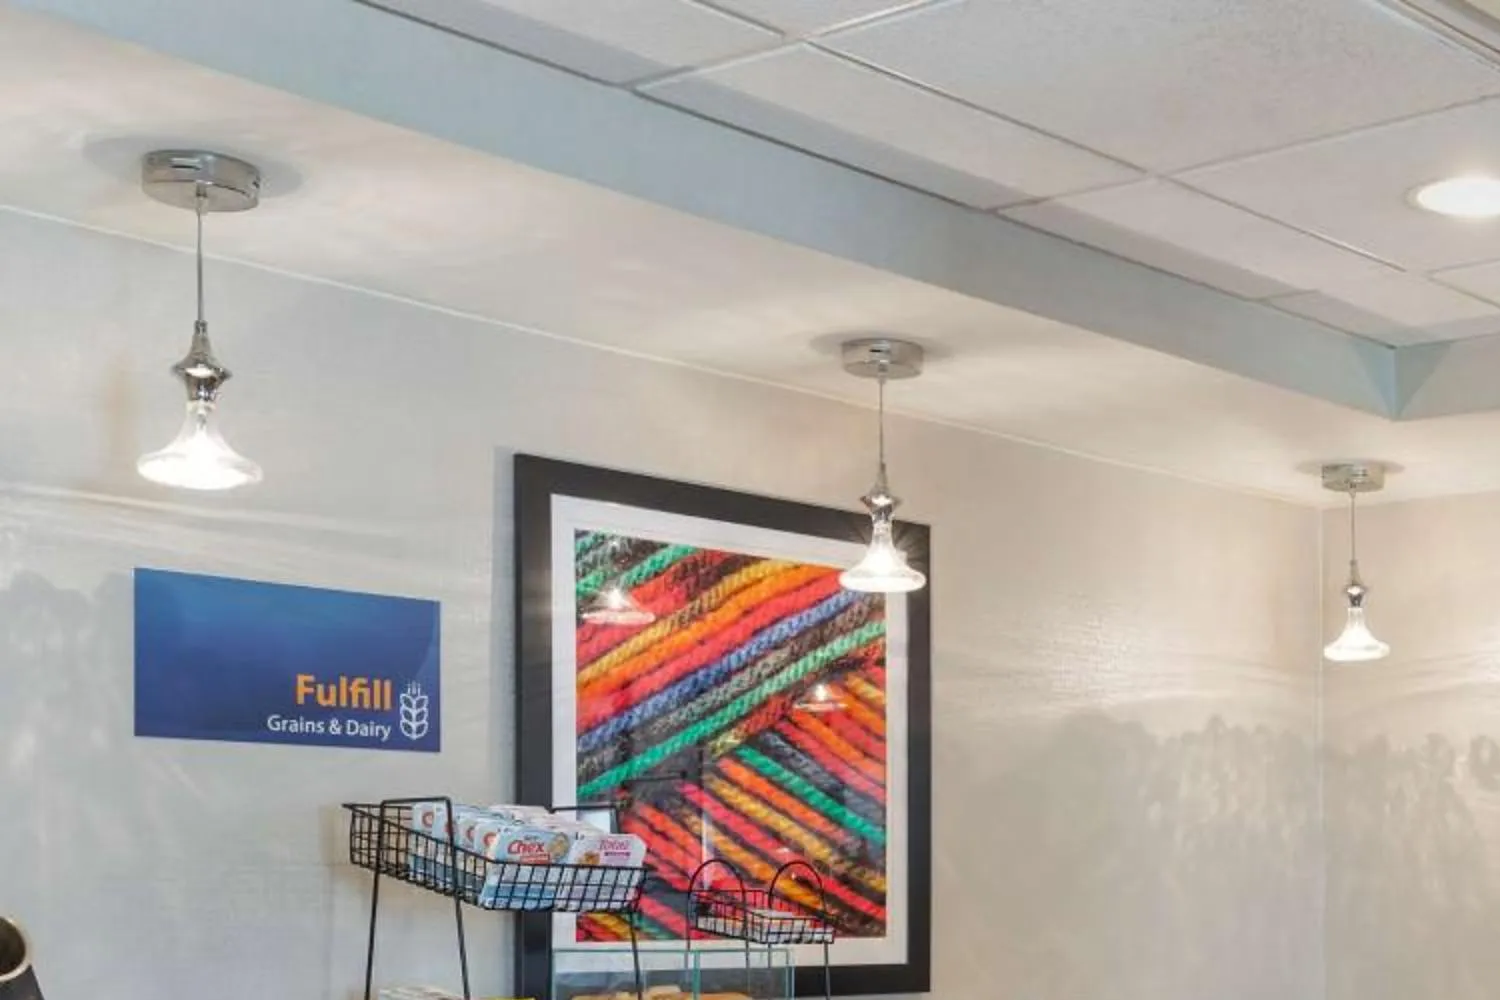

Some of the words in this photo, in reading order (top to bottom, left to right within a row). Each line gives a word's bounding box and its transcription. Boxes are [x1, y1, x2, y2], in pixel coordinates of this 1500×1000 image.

[294, 672, 393, 711] Fulfill
[266, 713, 325, 735] Grains
[328, 719, 343, 736] &
[346, 719, 392, 742] Dairy
[507, 838, 546, 855] Chex
